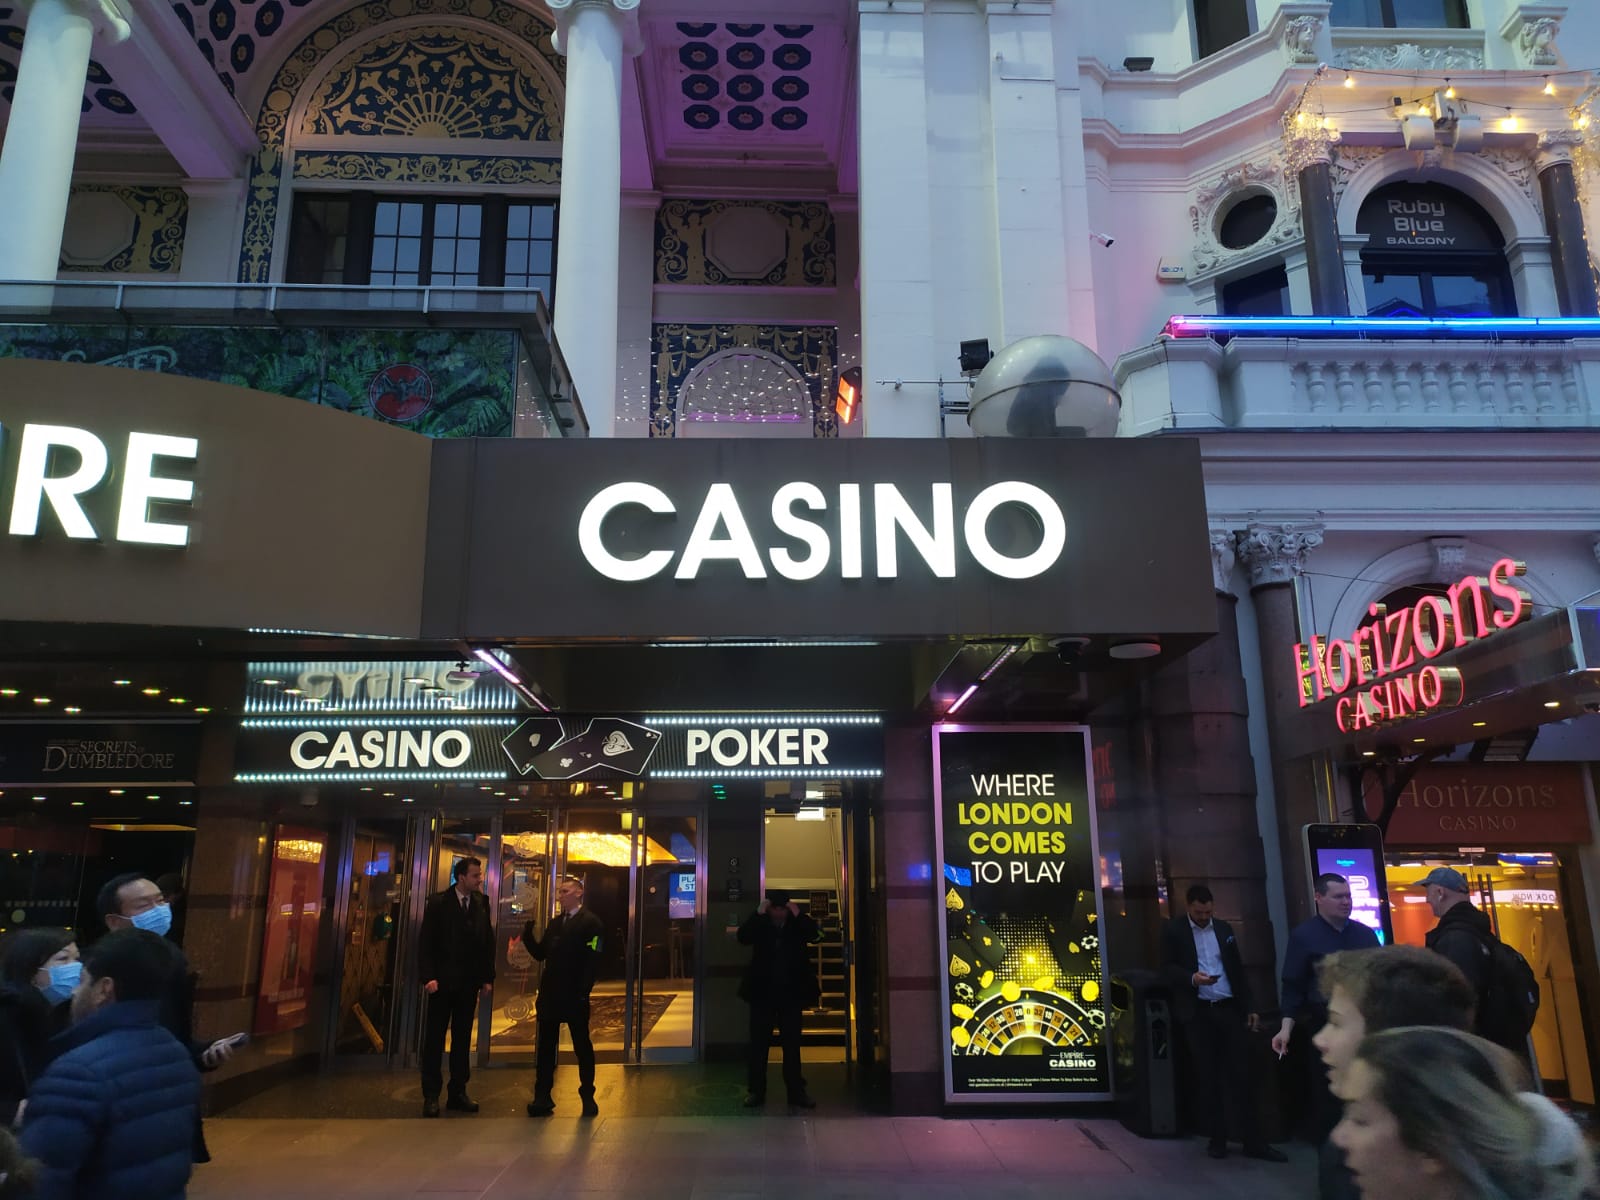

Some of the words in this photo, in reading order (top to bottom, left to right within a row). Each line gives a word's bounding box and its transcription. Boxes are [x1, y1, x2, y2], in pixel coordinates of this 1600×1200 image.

[1387, 199, 1446, 217] Ruby
[1393, 216, 1445, 232] Blue
[1386, 236, 1456, 246] BALCONY
[0, 423, 199, 547] RE
[577, 480, 1067, 581] CASINO
[1293, 558, 1528, 708] Horizons
[1335, 665, 1446, 734] CASINO
[42, 745, 175, 773] DUMBLEDORE
[79, 740, 138, 754] SECRETS
[289, 729, 472, 770] CASINO
[686, 728, 830, 767] POKER
[970, 773, 1056, 797] WHERE
[1397, 778, 1557, 809] Horizons
[958, 801, 1073, 826] LONDON
[1438, 814, 1518, 832] CASINO
[968, 831, 1066, 855] COMES
[970, 860, 1003, 884] TO
[1009, 860, 1066, 884] PLAY
[1048, 1059, 1097, 1068] CASINO
[1059, 1050, 1084, 1060] EMPIRE
